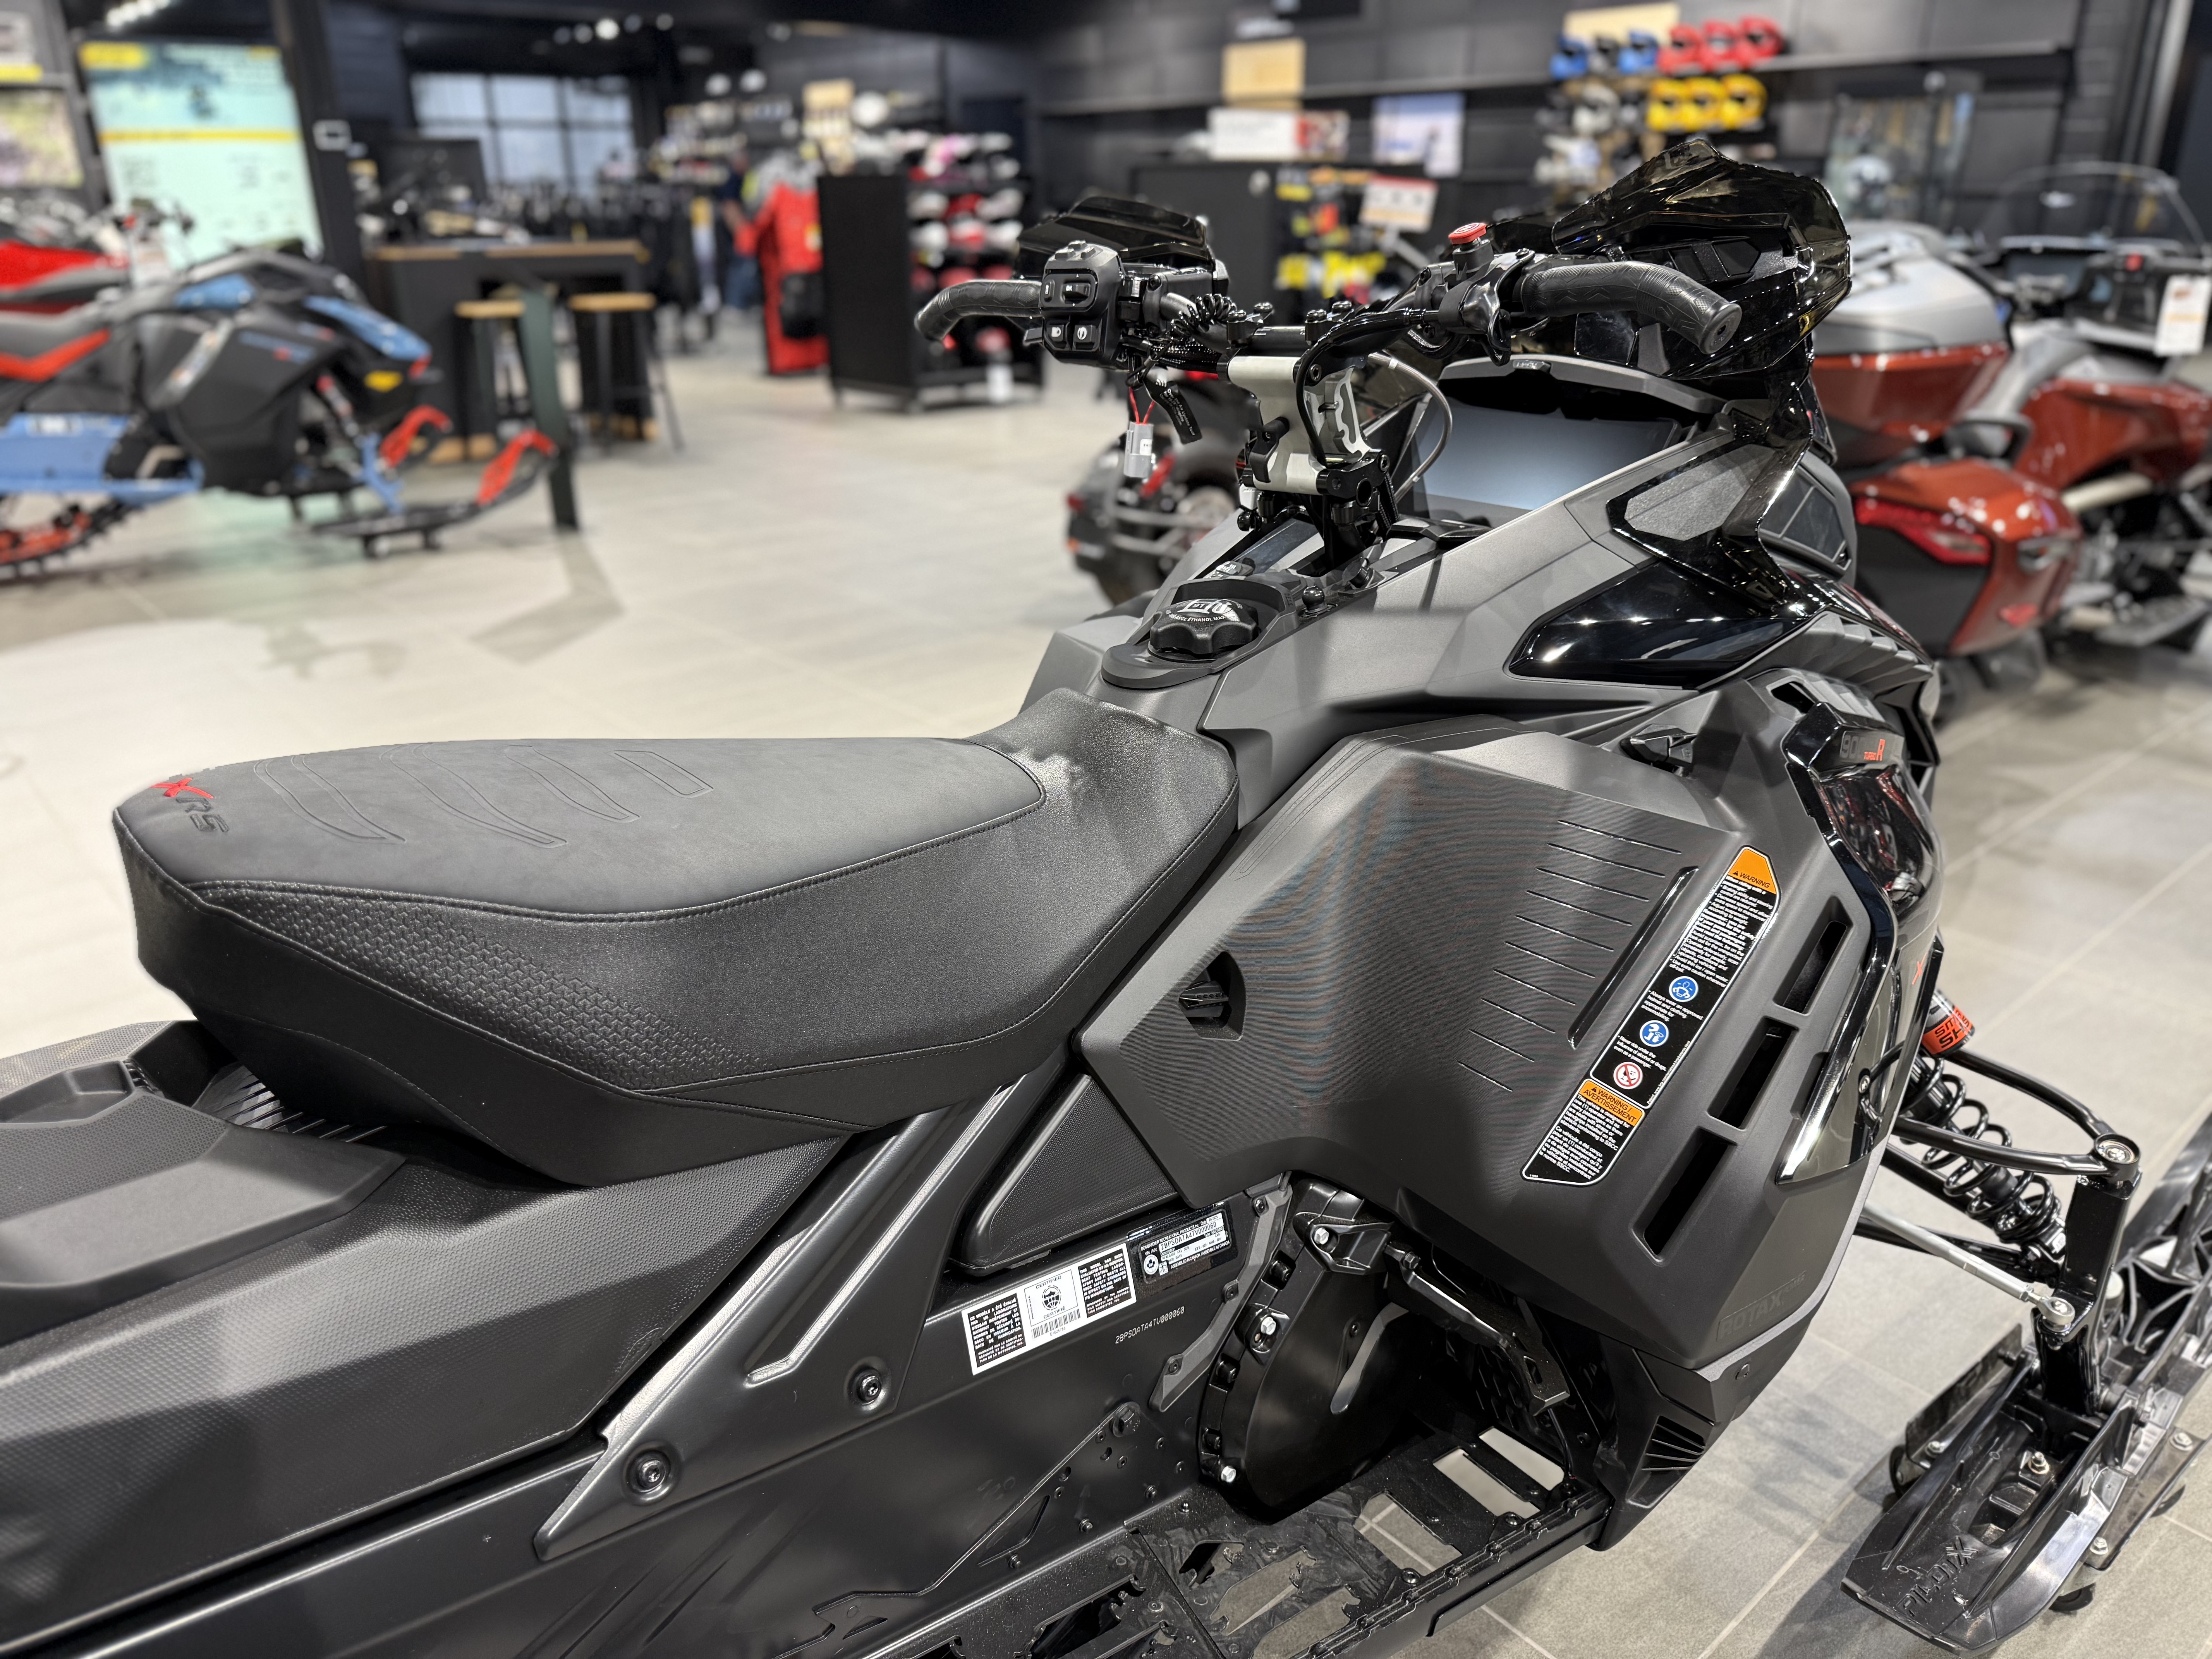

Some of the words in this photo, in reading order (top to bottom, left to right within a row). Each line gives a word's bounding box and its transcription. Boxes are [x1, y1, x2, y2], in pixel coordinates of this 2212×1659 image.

[1876, 739, 1885, 761] R
[1740, 872, 1770, 888] WARNING
[1583, 1089, 1637, 1122] AVERTISSEMENT
[1598, 1089, 1628, 1110] WARNING
[1140, 1239, 1160, 1251] BOMBARDIER
[1179, 1224, 1195, 1235] PRODUCTS
[1161, 1221, 1216, 1250] 2BPSDATA4TV000060
[1036, 1275, 1061, 1289] CERTIFIED
[1043, 1306, 1065, 1319] CERTIFIÉ
[1115, 1306, 1185, 1344] 2BPSDATA4TV000060
